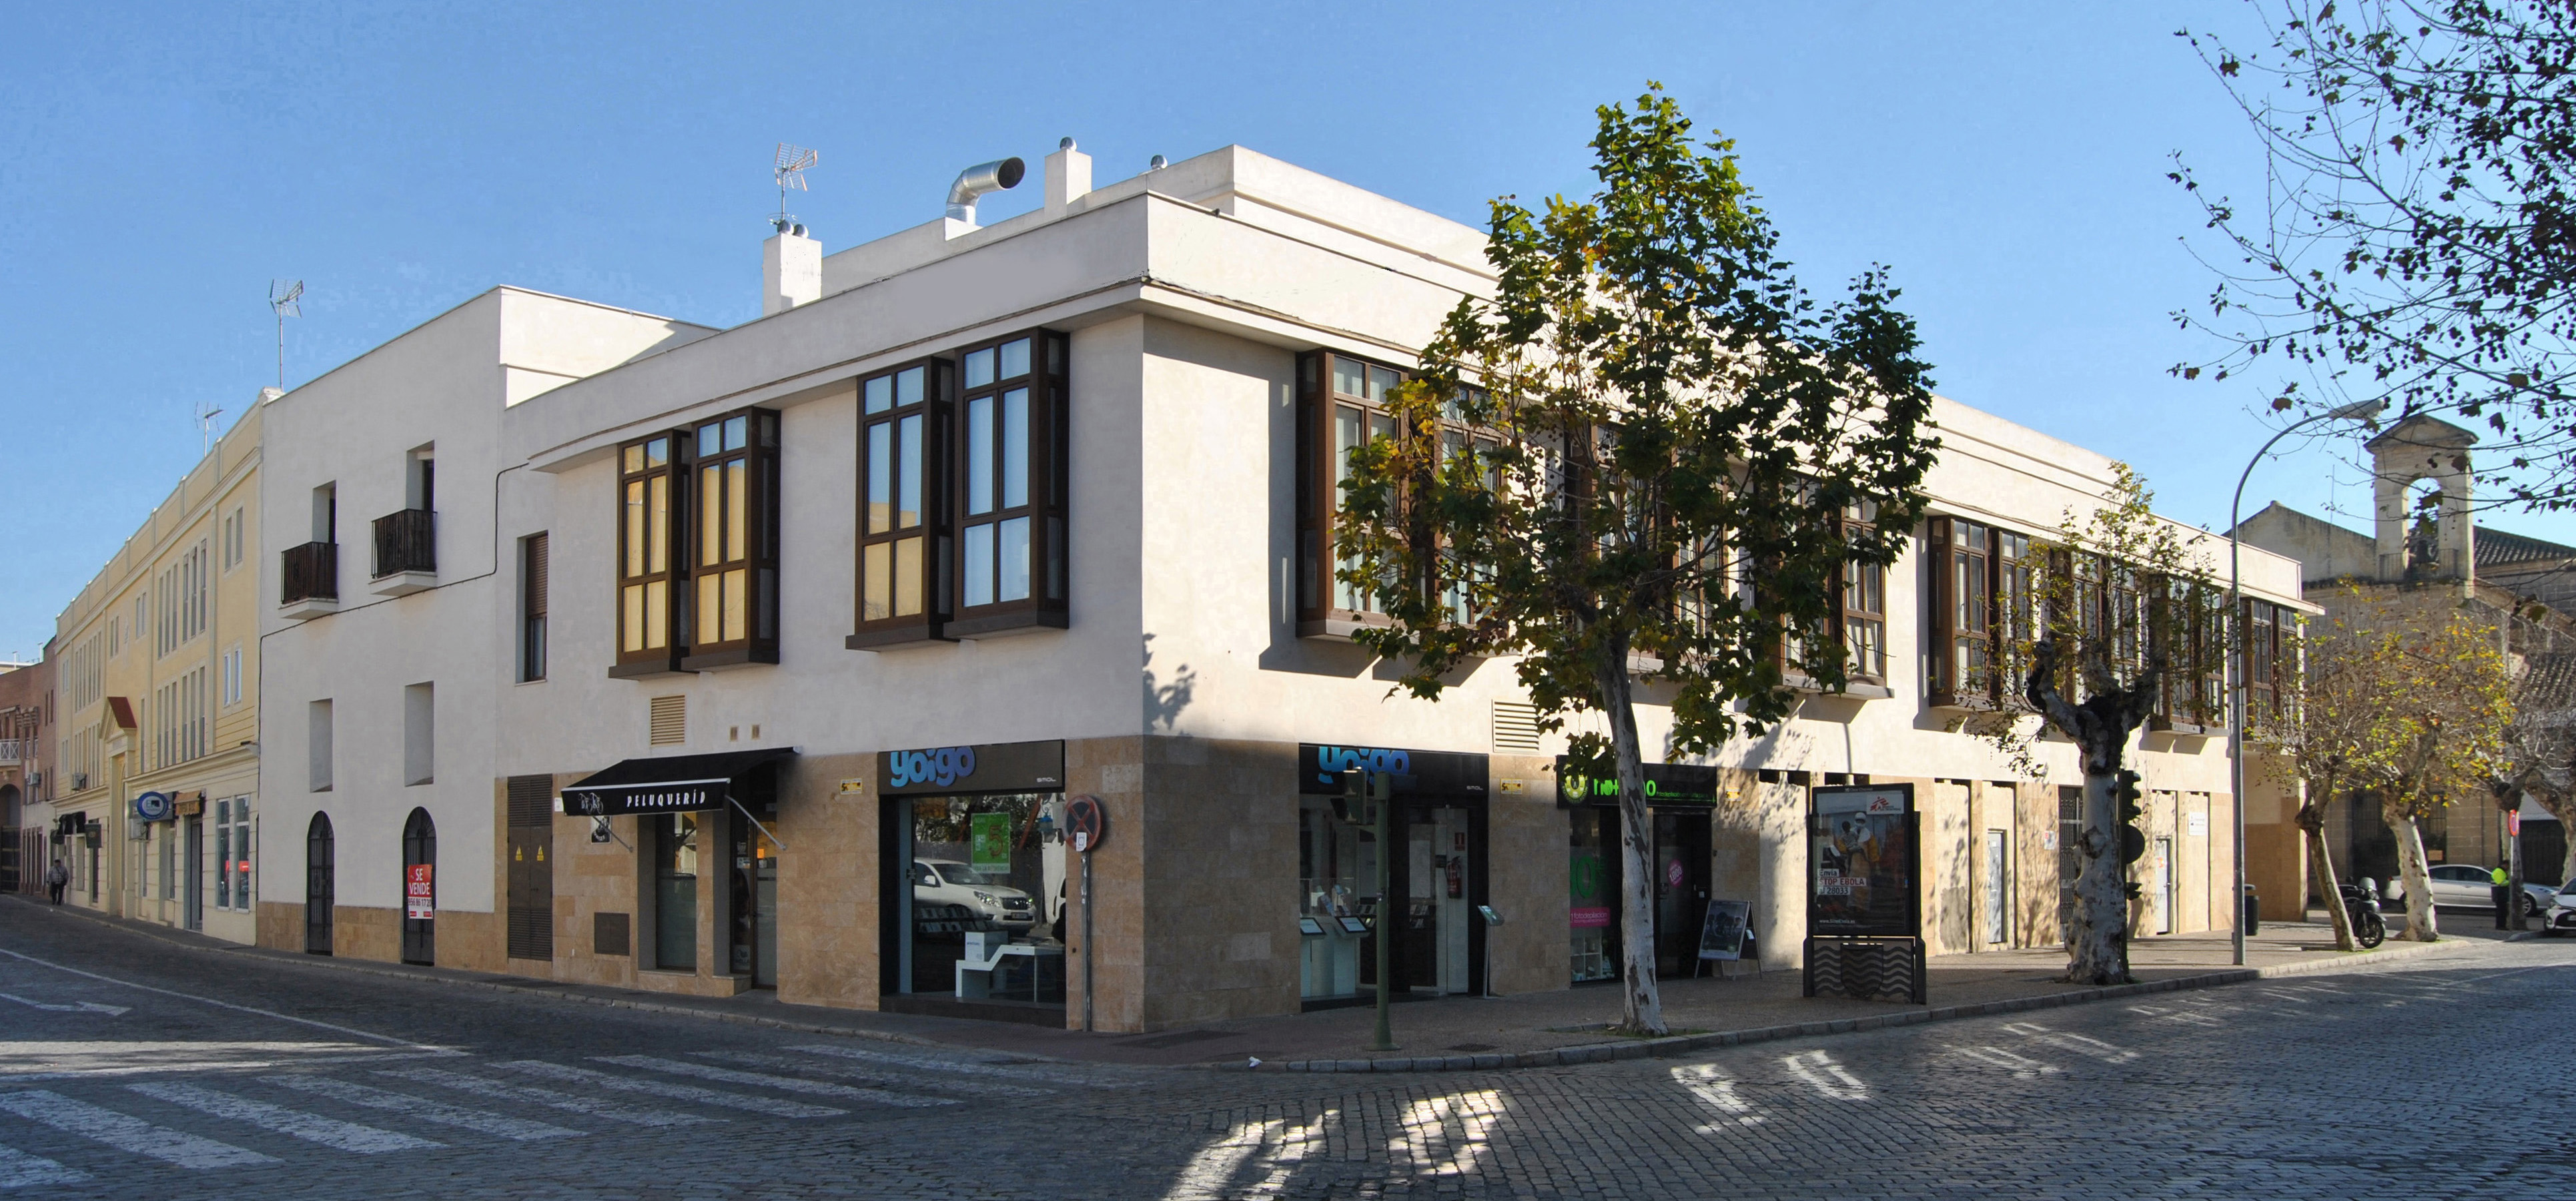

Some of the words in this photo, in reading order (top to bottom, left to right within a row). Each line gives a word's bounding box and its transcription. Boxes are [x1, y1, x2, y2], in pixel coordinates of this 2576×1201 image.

[890, 745, 976, 787] yoigo
[416, 868, 423, 881] SE
[409, 882, 430, 895] VENDE
